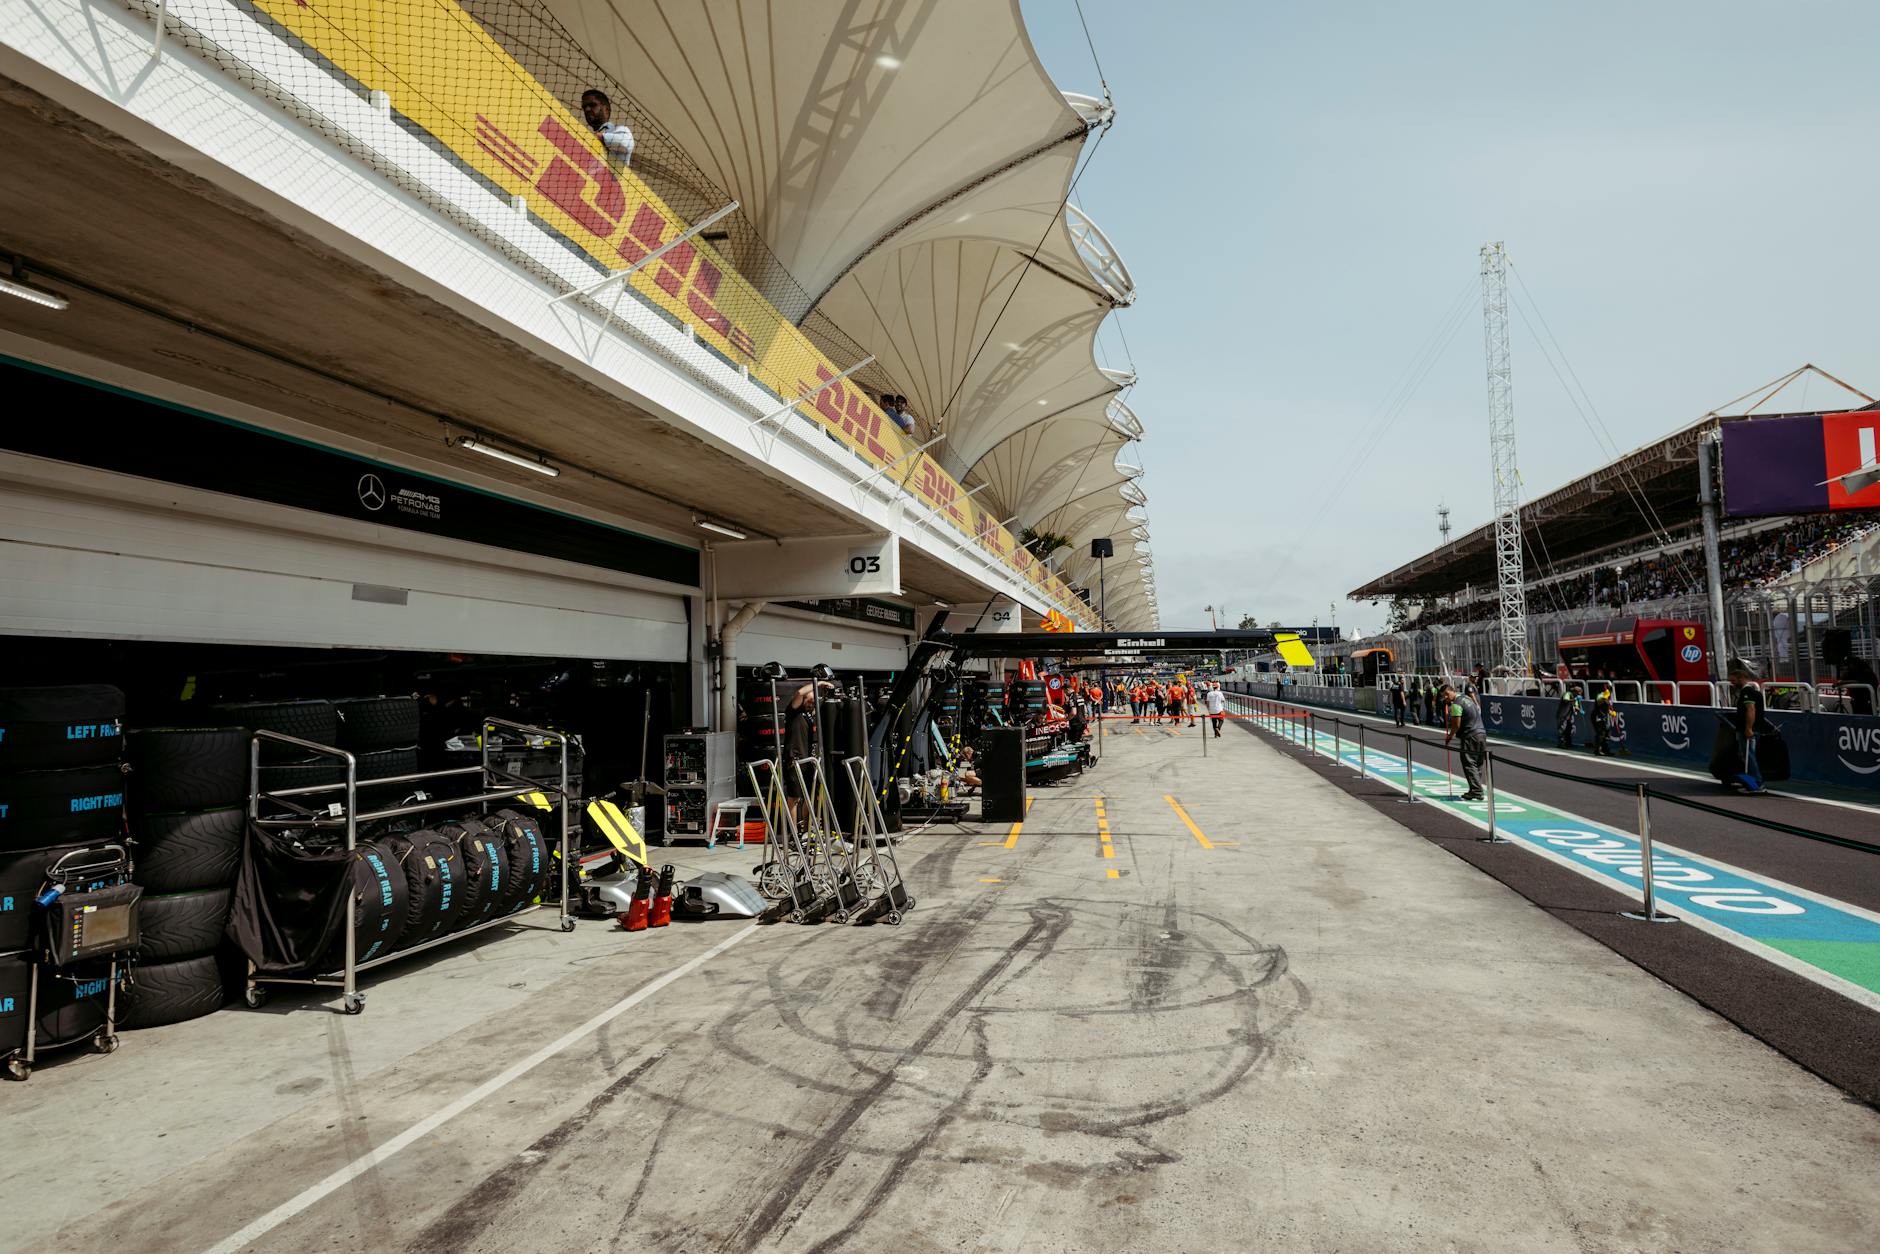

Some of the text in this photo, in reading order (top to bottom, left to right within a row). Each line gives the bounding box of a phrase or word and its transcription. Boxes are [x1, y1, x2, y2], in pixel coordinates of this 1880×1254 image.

[534, 115, 731, 338] DHL
[815, 363, 886, 461] DHL
[921, 460, 957, 519] DHL
[390, 494, 440, 513] PETRONAS
[850, 556, 880, 574] 03
[993, 611, 1011, 622] 04
[1117, 638, 1165, 647] Einhell
[1683, 645, 1700, 662] hp
[1521, 704, 1535, 719] aws
[67, 725, 97, 739] LEFT
[1661, 714, 1688, 735] aws
[1838, 726, 1880, 753] aws
[71, 796, 103, 812] RIGHT
[523, 828, 537, 846] LEFT
[531, 847, 540, 874] FRONT
[485, 842, 500, 892] RIGHT FRONT
[367, 854, 387, 878] RIGHT
[380, 880, 393, 907] REAR
[438, 857, 452, 911] LEFT REAR
